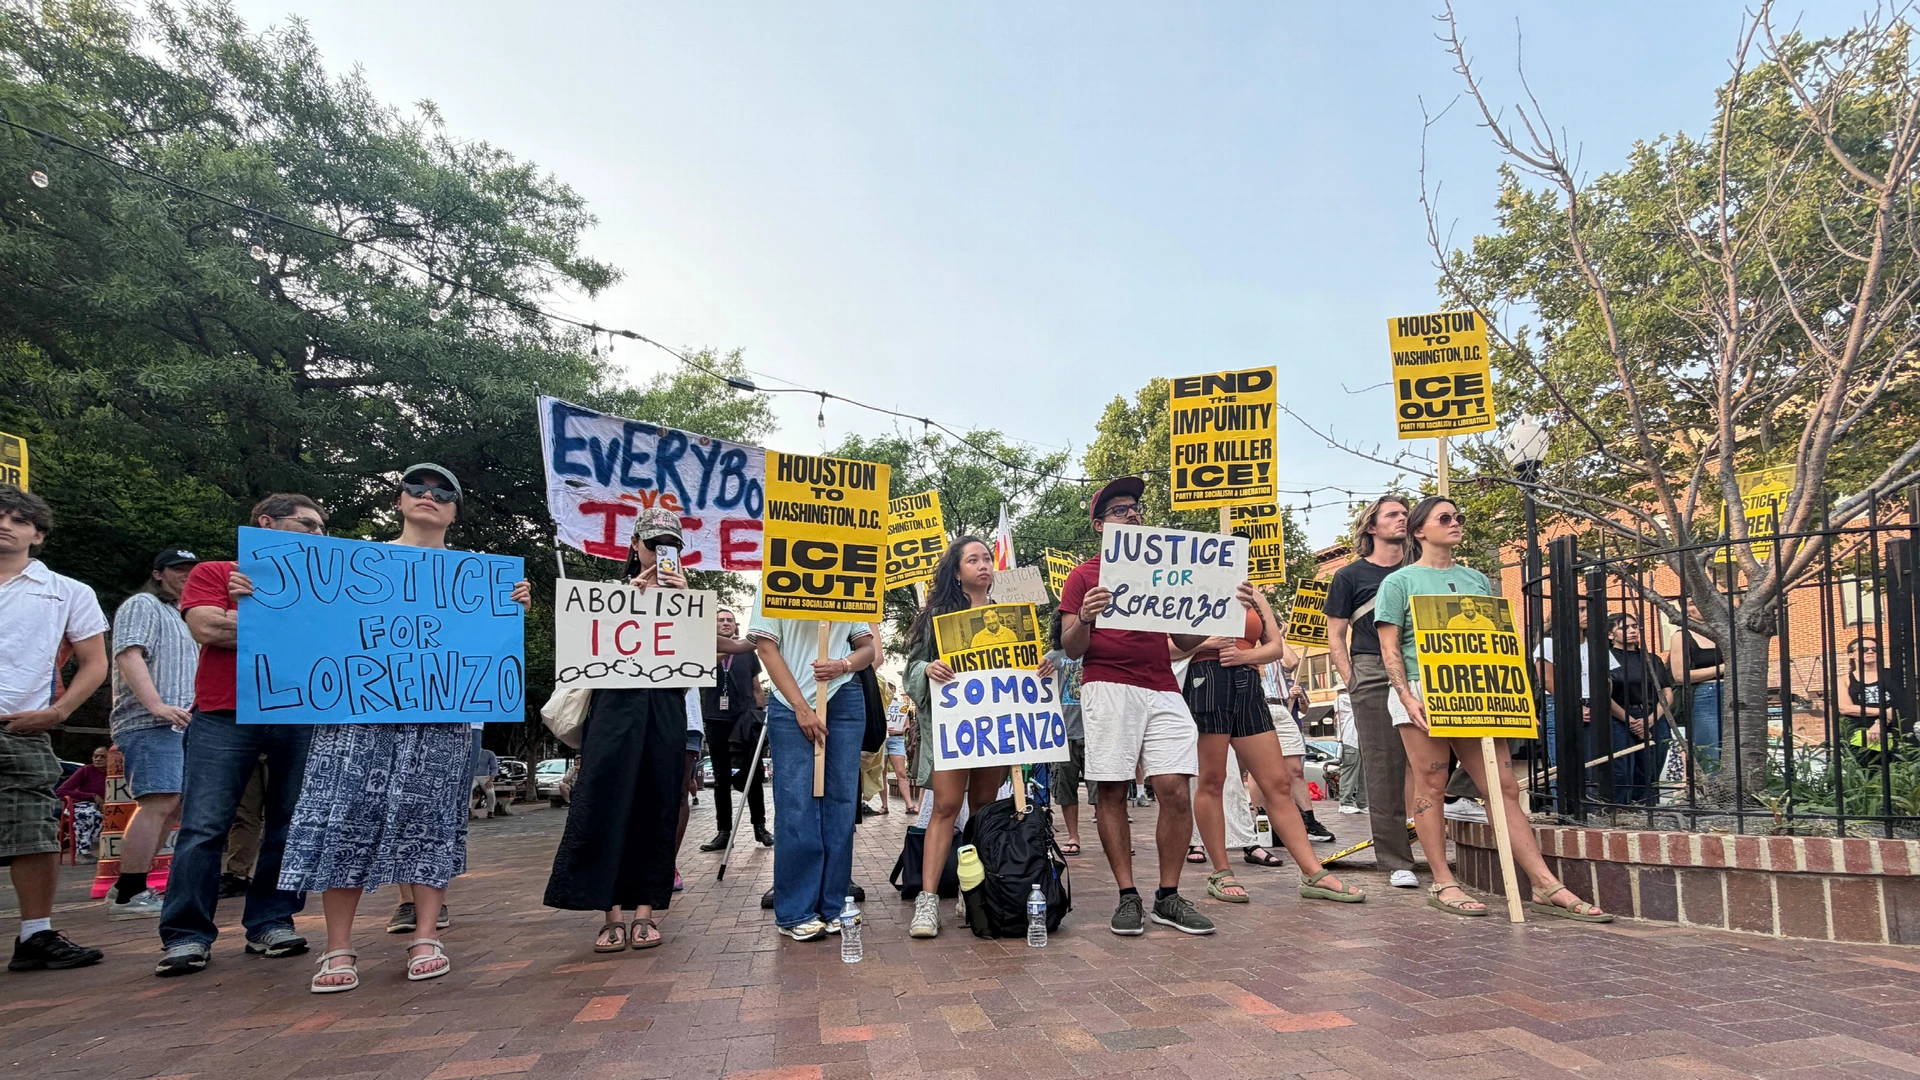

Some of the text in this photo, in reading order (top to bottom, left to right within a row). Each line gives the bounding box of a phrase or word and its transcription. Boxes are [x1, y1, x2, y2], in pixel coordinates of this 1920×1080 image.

[1398, 312, 1475, 337] HOUSTON
[1423, 335, 1450, 346] TO
[1393, 345, 1482, 366] WASHINGTON, D.C.
[1174, 370, 1273, 398] END
[1399, 372, 1484, 400] ICE
[1209, 395, 1237, 404] THE
[1399, 396, 1486, 419] OUT!
[1173, 403, 1272, 435] IMPUNITY
[1400, 422, 1416, 430] PARTY
[1416, 422, 1426, 430] FOR
[1175, 438, 1272, 466] FOR KILLER
[778, 453, 876, 491] HOUSTON
[1176, 462, 1271, 489] ICE!
[810, 487, 844, 501] TO
[1175, 492, 1192, 500] PARTY
[1193, 491, 1204, 499] FOR
[1204, 489, 1233, 498] SOCIALISM
[1239, 486, 1271, 496] LIBERATION
[768, 500, 882, 530] WASHINGTON, D.C.
[887, 516, 939, 535] SHINGTON, D.C.
[896, 511, 915, 519] TO
[770, 538, 878, 573] ICE
[1105, 530, 1235, 567] JUSTICE
[1248, 544, 1280, 558] KILLER
[250, 542, 519, 616] JUSTICE
[1050, 561, 1072, 576] IMP
[1152, 569, 1193, 587] FOR
[766, 570, 877, 598] OUT!
[1052, 577, 1066, 587] FO
[1300, 580, 1331, 592] EN
[565, 586, 704, 618] ABOLISH
[766, 597, 876, 611] PARTY FOR SOCIALISM & LIBERATION
[1292, 612, 1308, 623] FOR
[359, 615, 442, 650] FOR
[591, 619, 675, 656] ICE
[1420, 633, 1519, 656] JUSTICE FOR
[950, 644, 1038, 673] JUSTICE FOR
[255, 651, 522, 715] LORENZO
[939, 676, 1053, 708] SOMOS
[1423, 664, 1526, 695] LORENZO
[1428, 696, 1530, 713] SALGADO ARAUJO
[1431, 716, 1450, 724] PARTY
[1463, 716, 1495, 725] SOCIALISM
[1501, 717, 1531, 726] LIBERATION
[939, 711, 1065, 759] LORENZO
